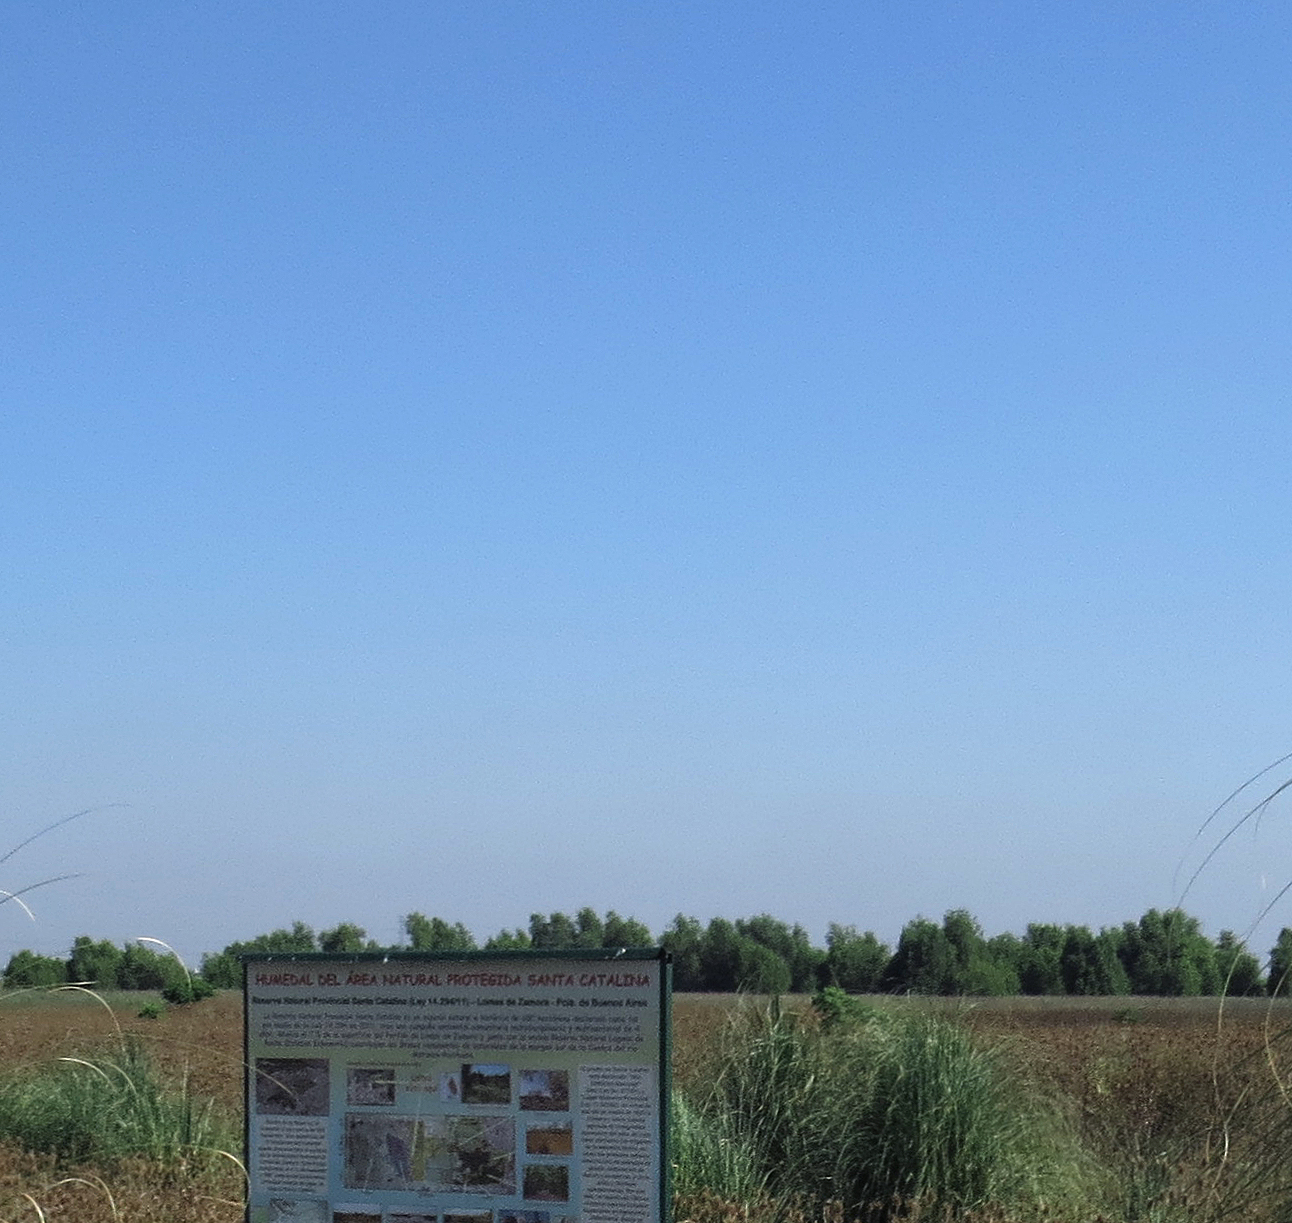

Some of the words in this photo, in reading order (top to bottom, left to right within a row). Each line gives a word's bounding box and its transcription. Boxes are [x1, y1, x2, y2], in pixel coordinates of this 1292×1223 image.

[255, 973, 313, 986] HUMEDAL
[318, 973, 341, 986] DEL
[346, 970, 377, 986] ÁREA
[383, 974, 442, 986] NATURAL
[447, 974, 522, 987] PROTEGIDA
[528, 974, 574, 987] SANTA
[579, 974, 650, 987] CATALINA
